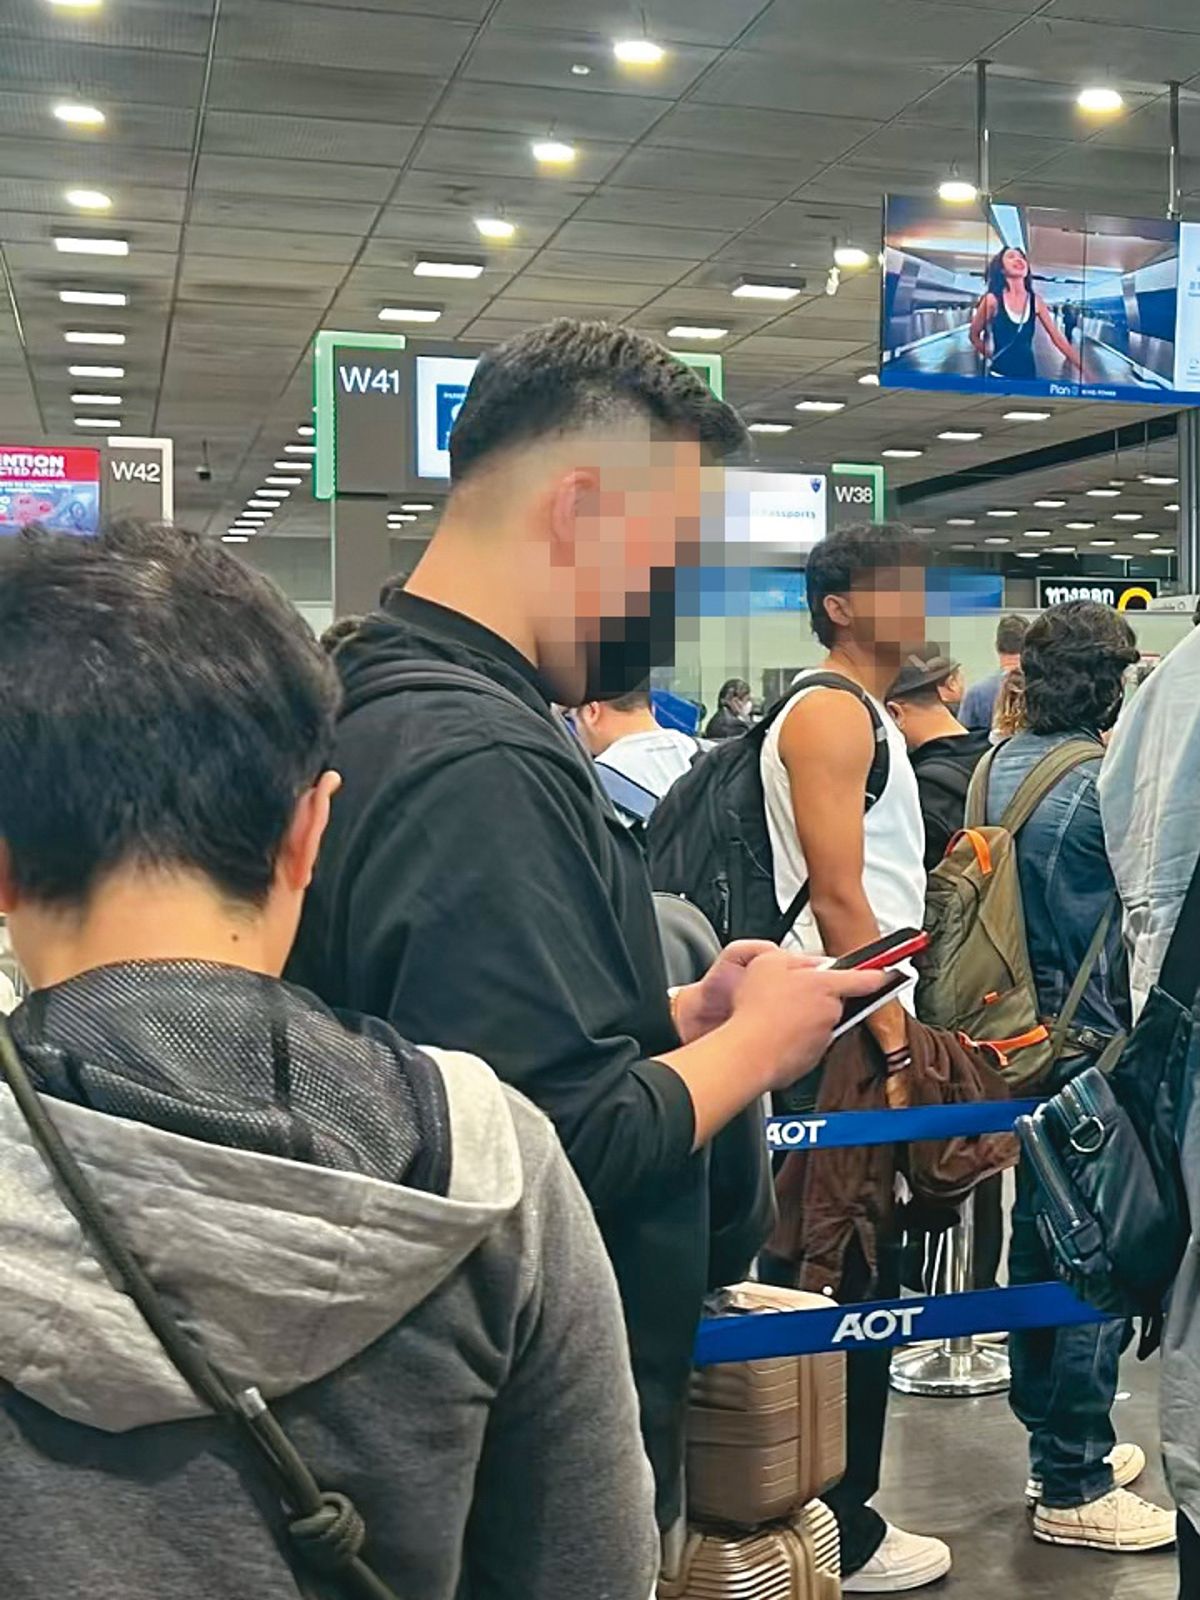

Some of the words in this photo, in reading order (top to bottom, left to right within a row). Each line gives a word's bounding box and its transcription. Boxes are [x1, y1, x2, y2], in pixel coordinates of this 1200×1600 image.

[339, 366, 400, 394] W41
[0, 453, 65, 468] NTION
[111, 461, 161, 483] W42
[835, 486, 873, 503] W38
[766, 1120, 827, 1145] AOT
[831, 1306, 924, 1344] AOT
